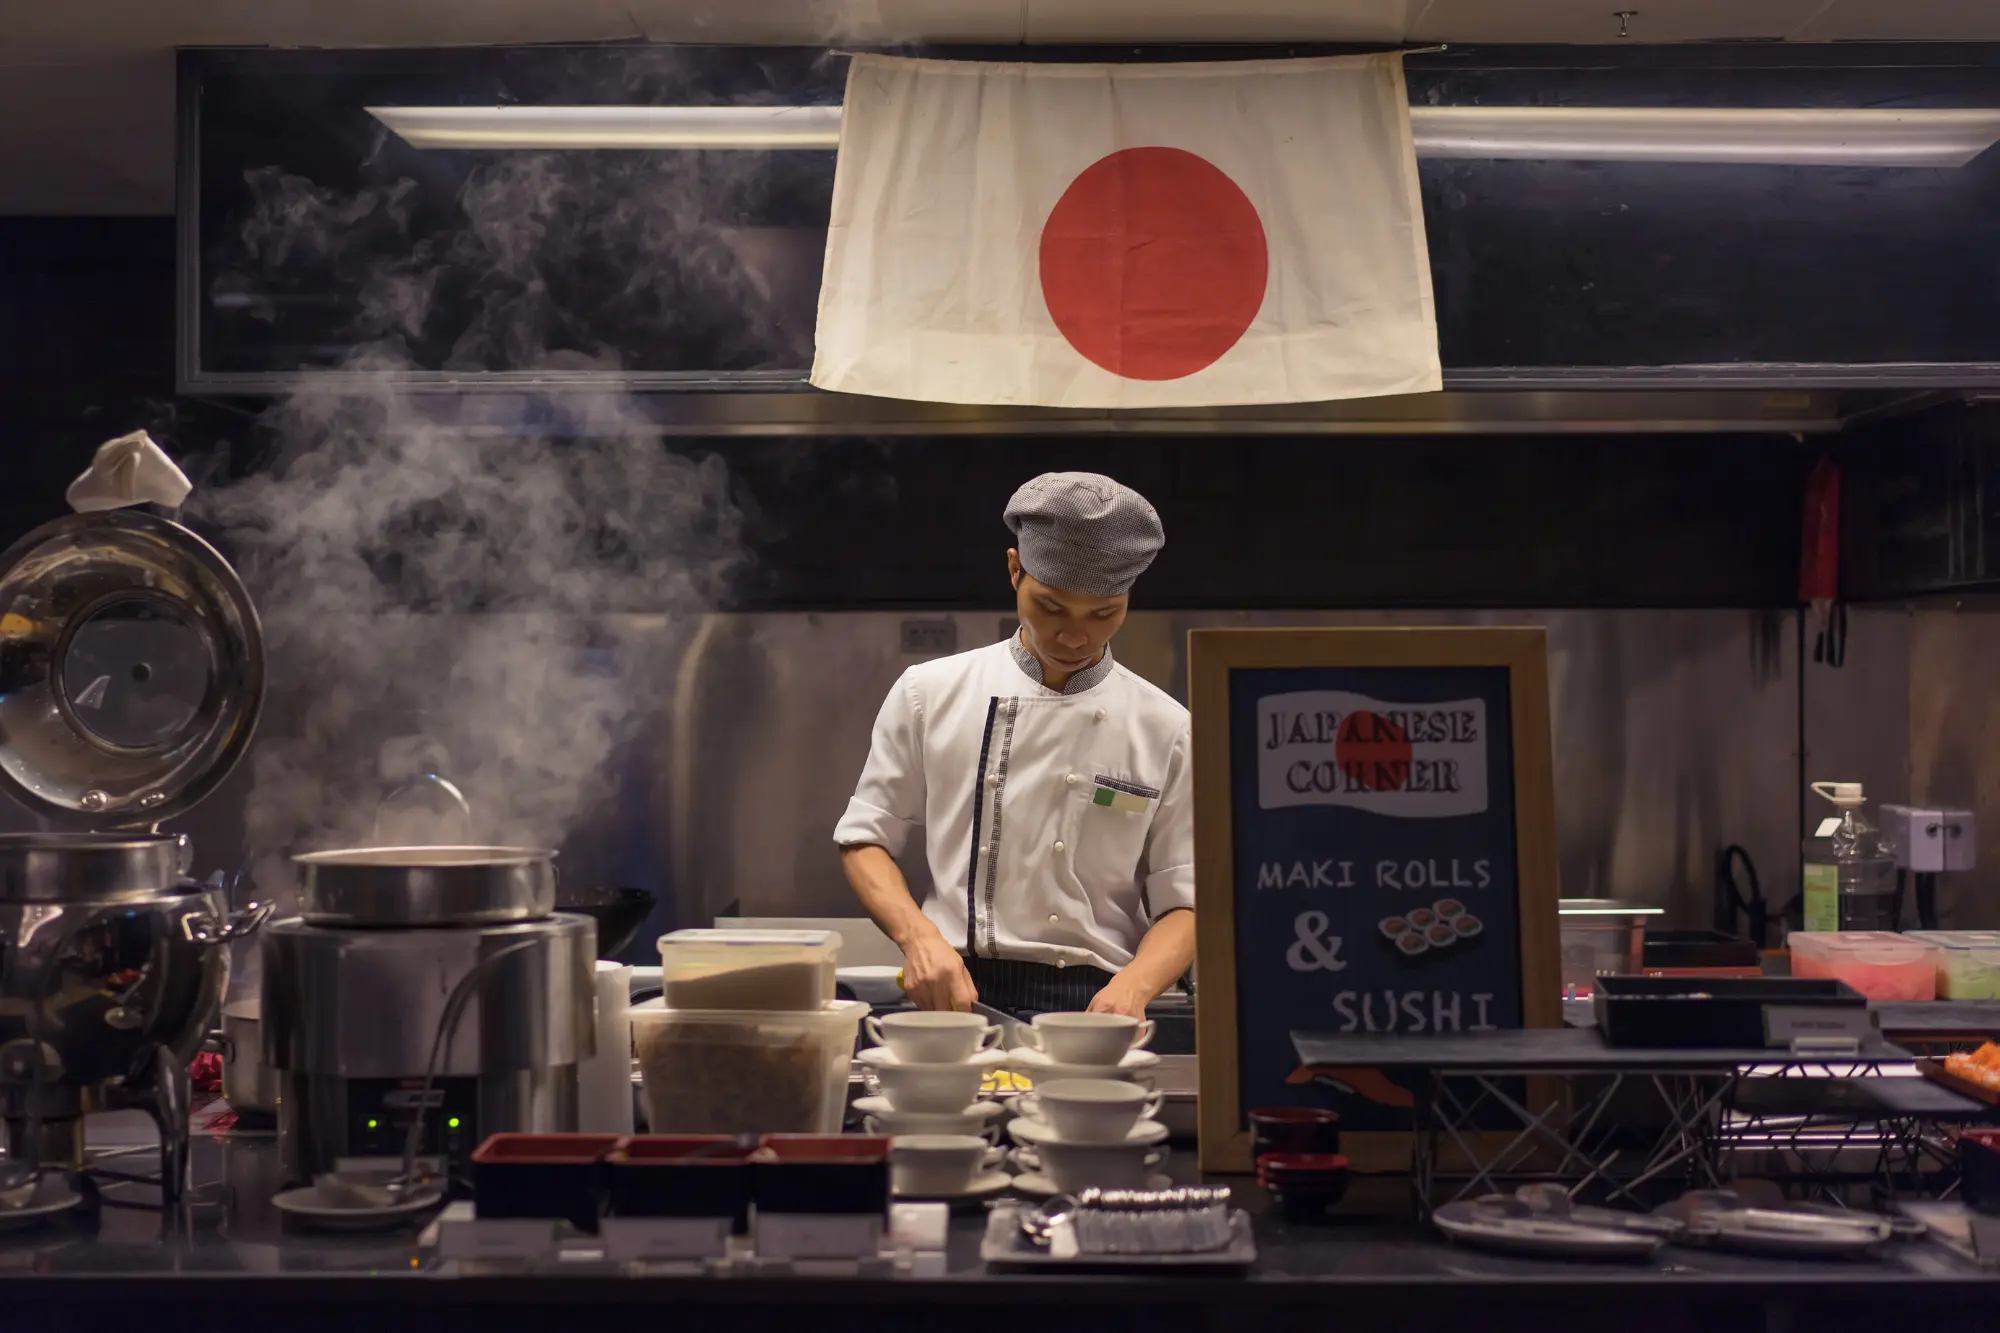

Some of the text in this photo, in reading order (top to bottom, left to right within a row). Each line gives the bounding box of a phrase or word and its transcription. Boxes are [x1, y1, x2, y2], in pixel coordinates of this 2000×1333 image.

[1266, 709, 1477, 750] JAPANESE
[1286, 760, 1463, 794] CORNER
[1257, 859, 1491, 890] MAKI ROLLS
[1286, 910, 1348, 972] &
[1332, 990, 1498, 1033] SUSHI
